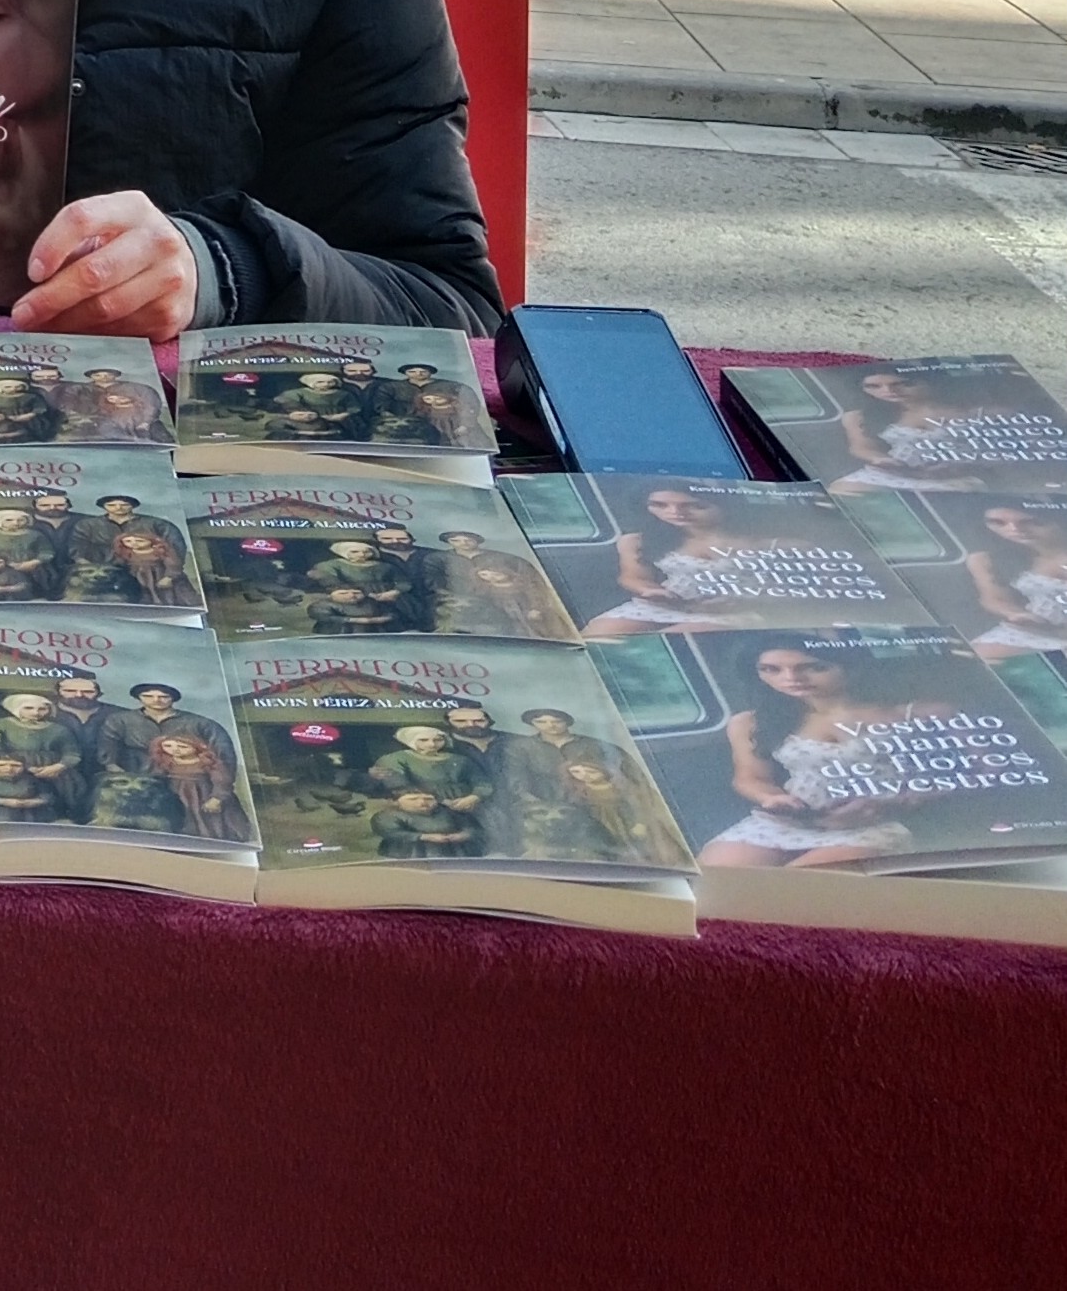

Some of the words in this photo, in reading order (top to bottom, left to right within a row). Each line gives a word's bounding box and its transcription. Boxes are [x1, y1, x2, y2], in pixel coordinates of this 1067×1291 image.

[206, 333, 384, 348] TERRITORIO
[924, 413, 1053, 428] Vestido
[946, 426, 1064, 438] blanco
[914, 439, 956, 451] de
[203, 489, 413, 507] TERRITORIO
[209, 519, 256, 527] KEVIN
[709, 546, 853, 559] Vestido
[733, 558, 864, 573] blanco
[694, 570, 740, 584] de
[754, 571, 877, 586] flores
[697, 583, 886, 600] silvestres
[804, 639, 846, 649] Kevin
[245, 658, 490, 679] TERRITORIO
[253, 697, 308, 707] KEVIN
[834, 712, 1004, 738] Vestido
[864, 732, 1018, 755] blanco
[821, 759, 876, 779] de
[891, 750, 1035, 774] flores
[827, 770, 1050, 799] silvestres
